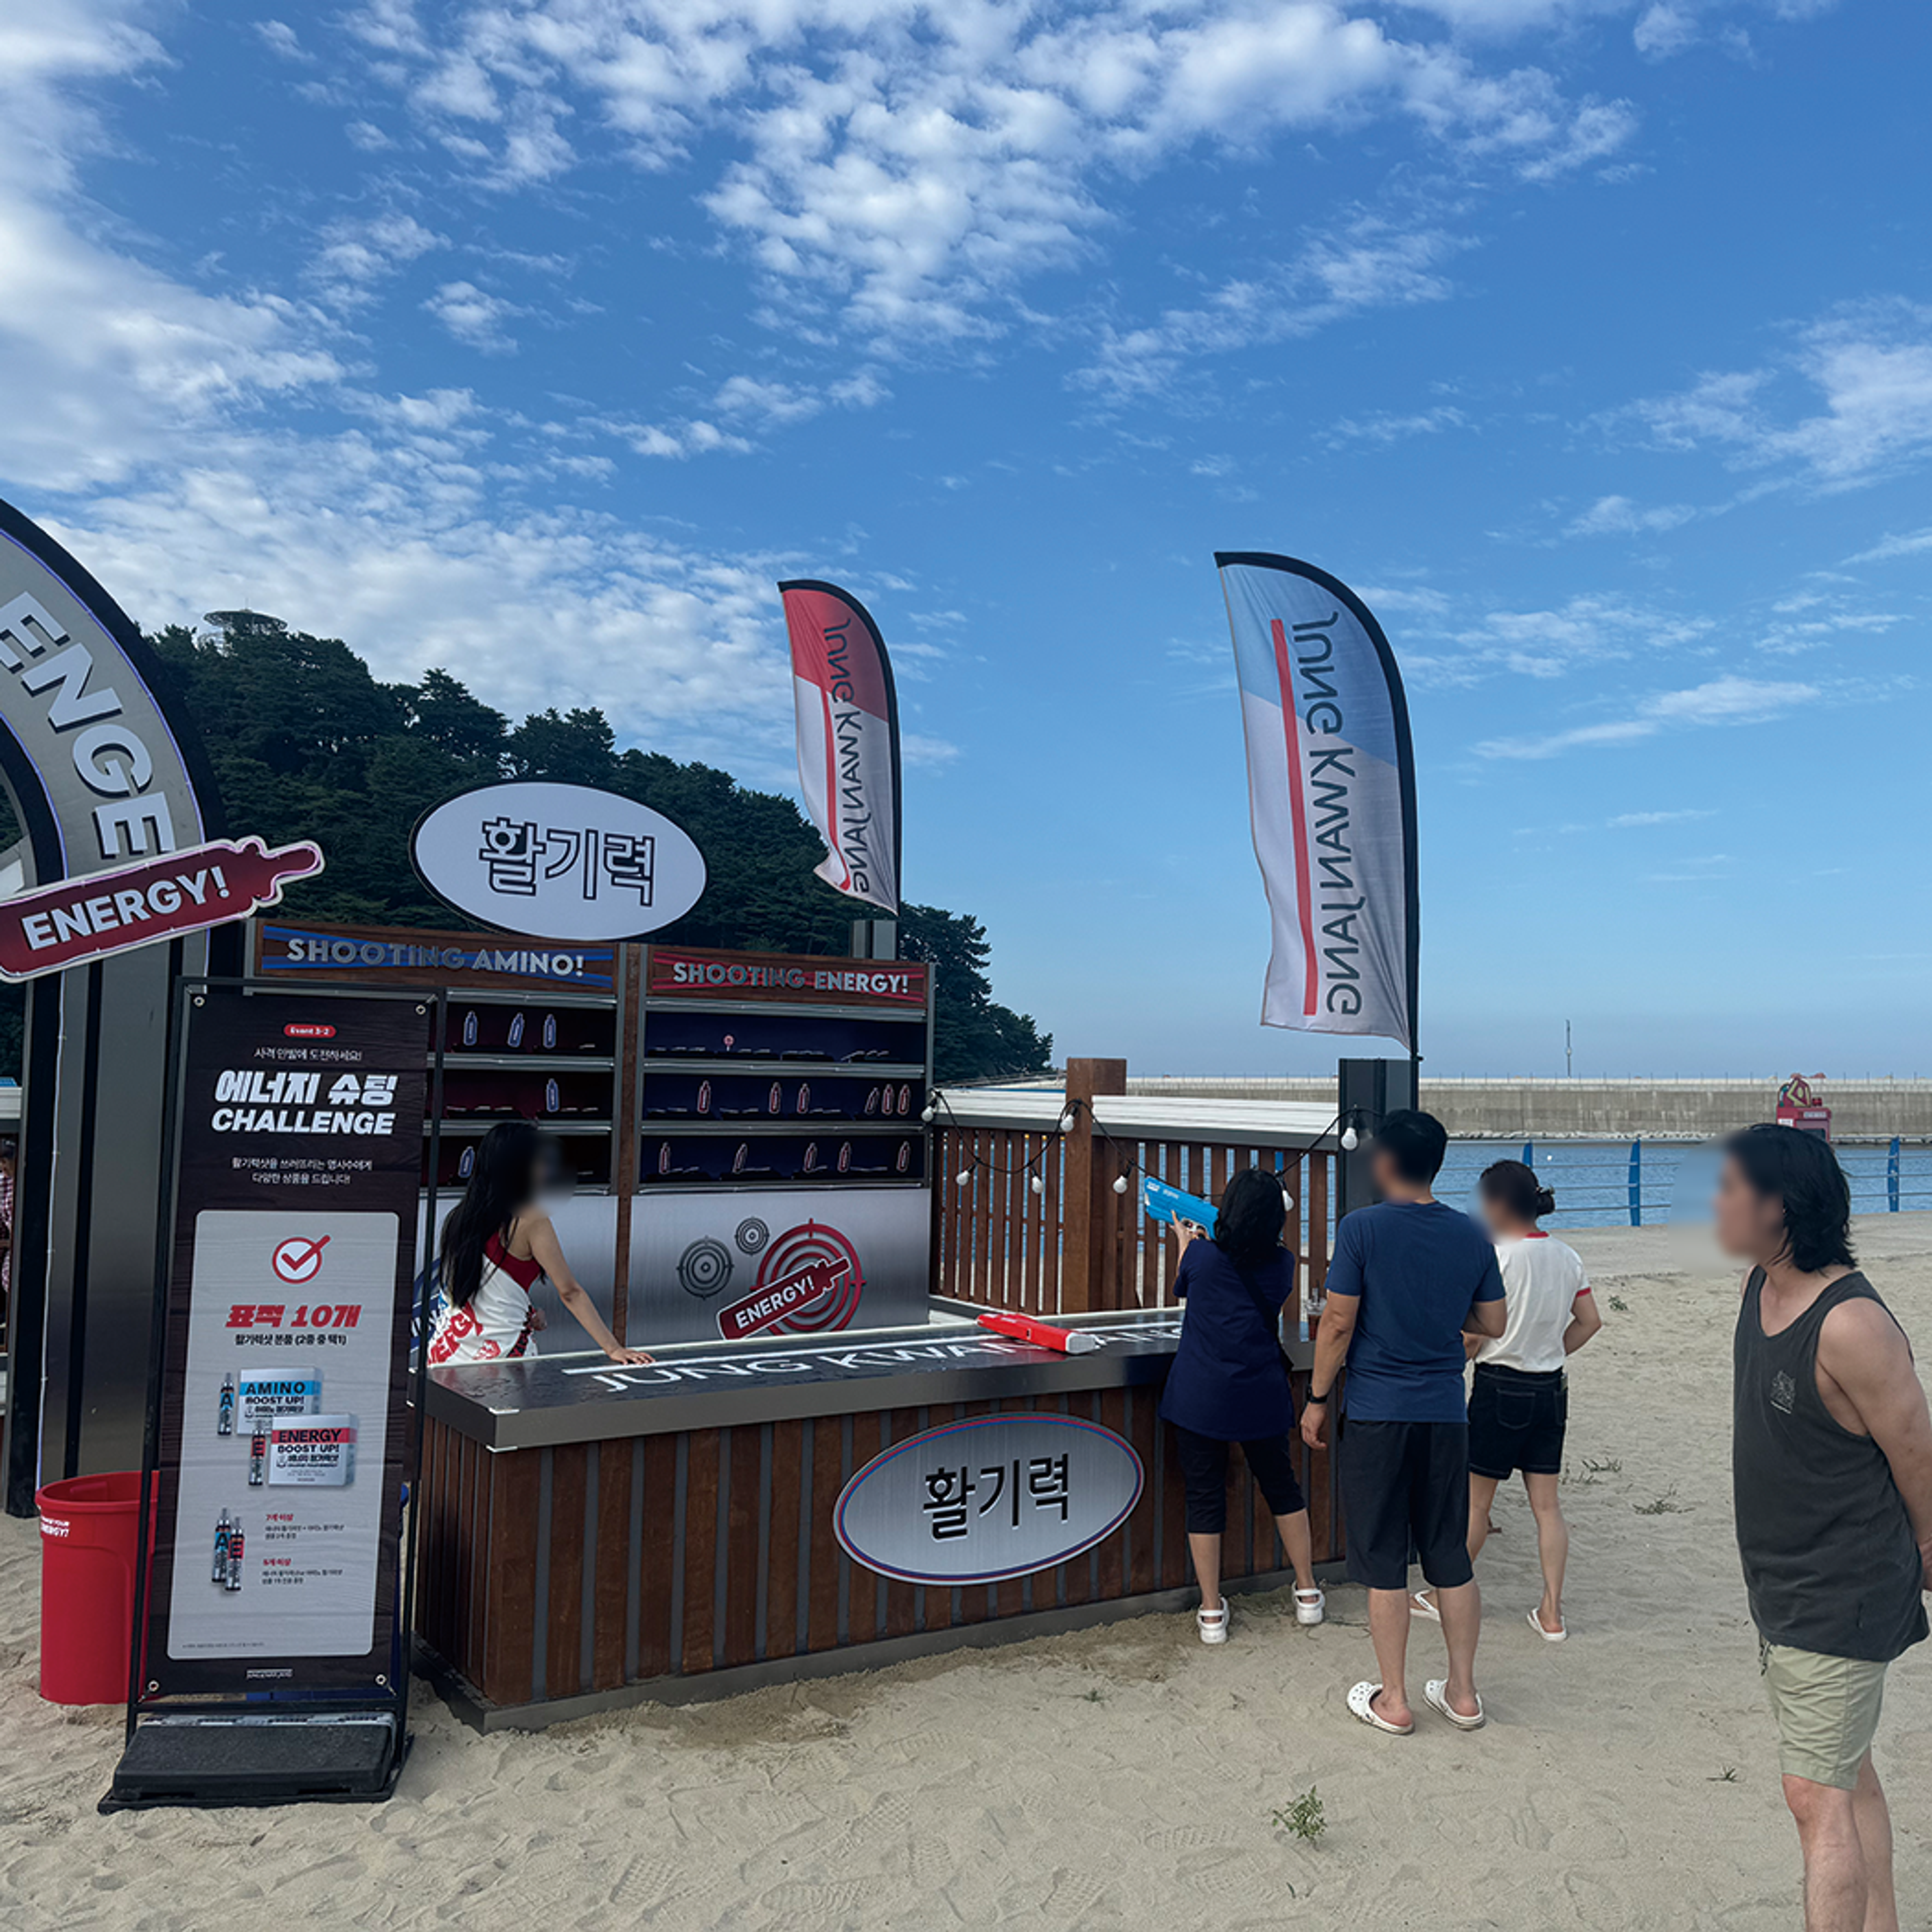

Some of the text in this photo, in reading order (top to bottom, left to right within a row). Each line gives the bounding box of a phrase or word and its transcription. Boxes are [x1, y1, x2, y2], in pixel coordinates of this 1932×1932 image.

[478, 816, 656, 908] 활기력
[21, 865, 230, 951] ENERGY!
[287, 938, 584, 977] SHOOTING AMINO!
[673, 962, 909, 994] SHOOTING ENERGY!
[214, 1070, 398, 1106] 에너지 슈팅
[211, 1107, 396, 1135] CHALLENGE
[225, 1305, 362, 1328] 표적 10개
[735, 1275, 815, 1329] ENERGY!
[245, 1382, 306, 1395] AMINO
[593, 1359, 813, 1393] JUNG
[245, 1396, 304, 1405] BOOST UP!
[278, 1444, 340, 1453] BOOST UP!
[279, 1429, 342, 1443] ENERGY
[922, 1453, 1070, 1542] 활기력
